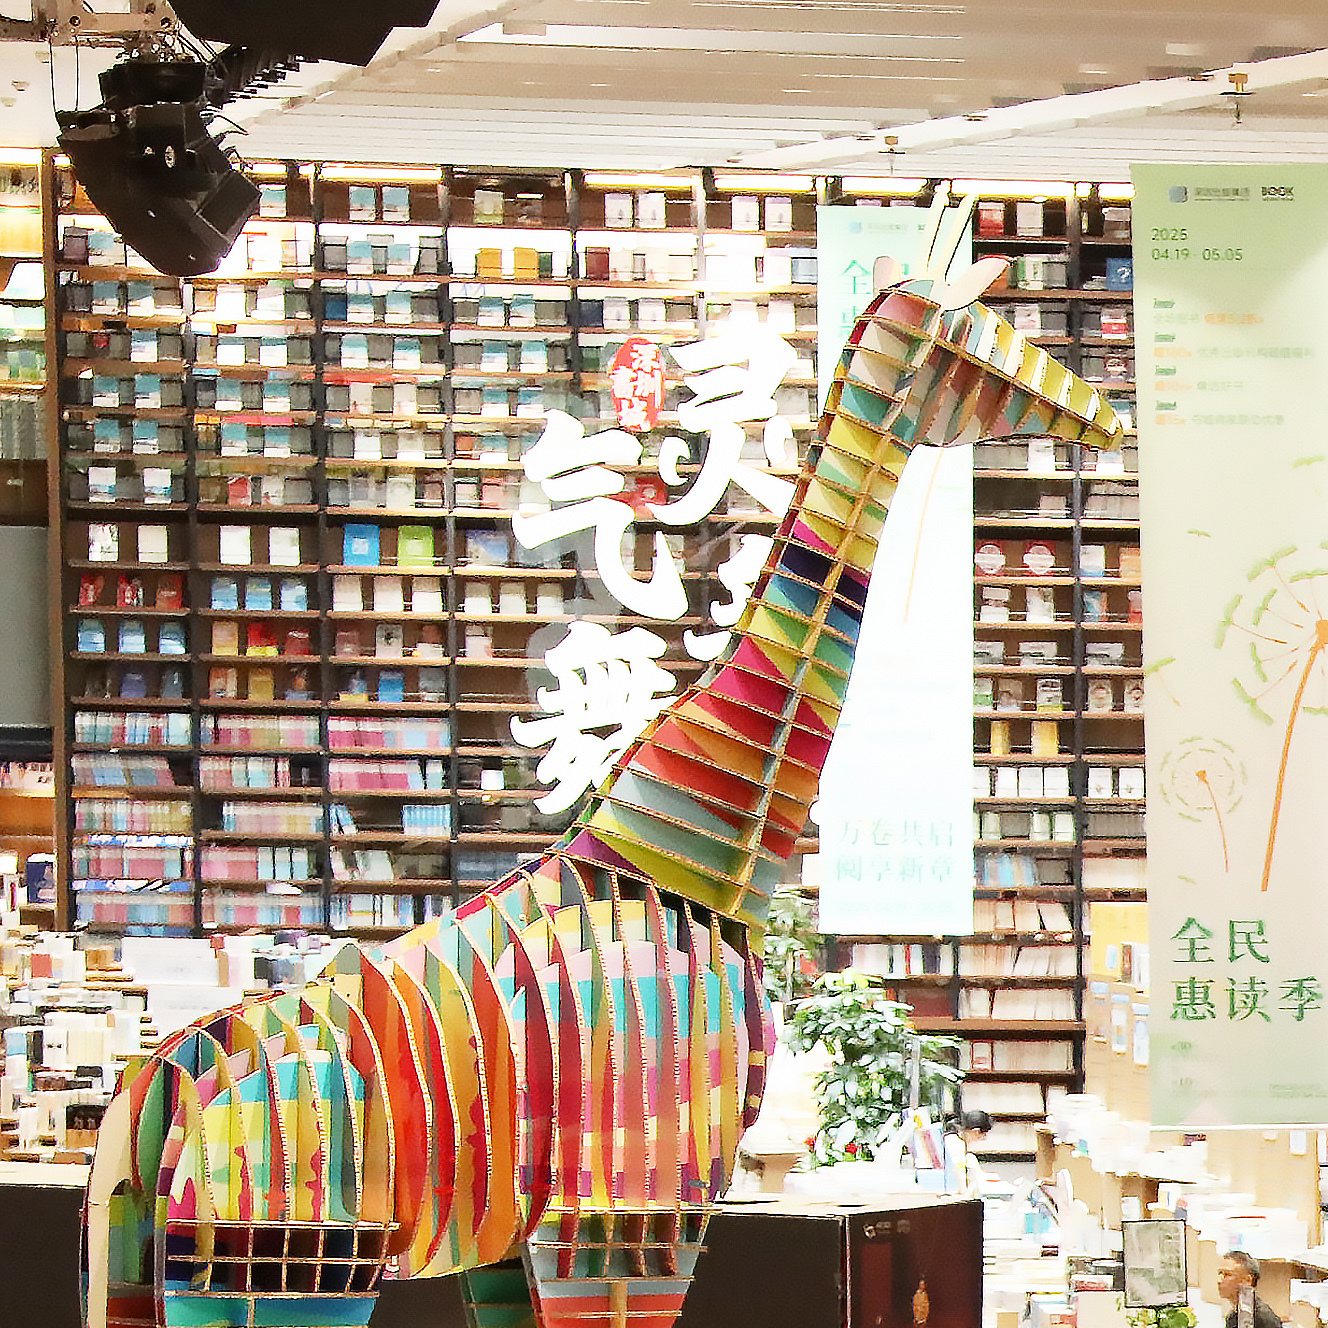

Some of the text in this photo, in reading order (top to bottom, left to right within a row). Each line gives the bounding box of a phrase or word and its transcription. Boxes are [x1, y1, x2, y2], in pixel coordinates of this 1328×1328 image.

[1151, 227, 1188, 241] 2025
[1151, 248, 1190, 261] 04.19
[1170, 917, 1270, 963] 全民
[1170, 976, 1323, 1022] 惠读季
